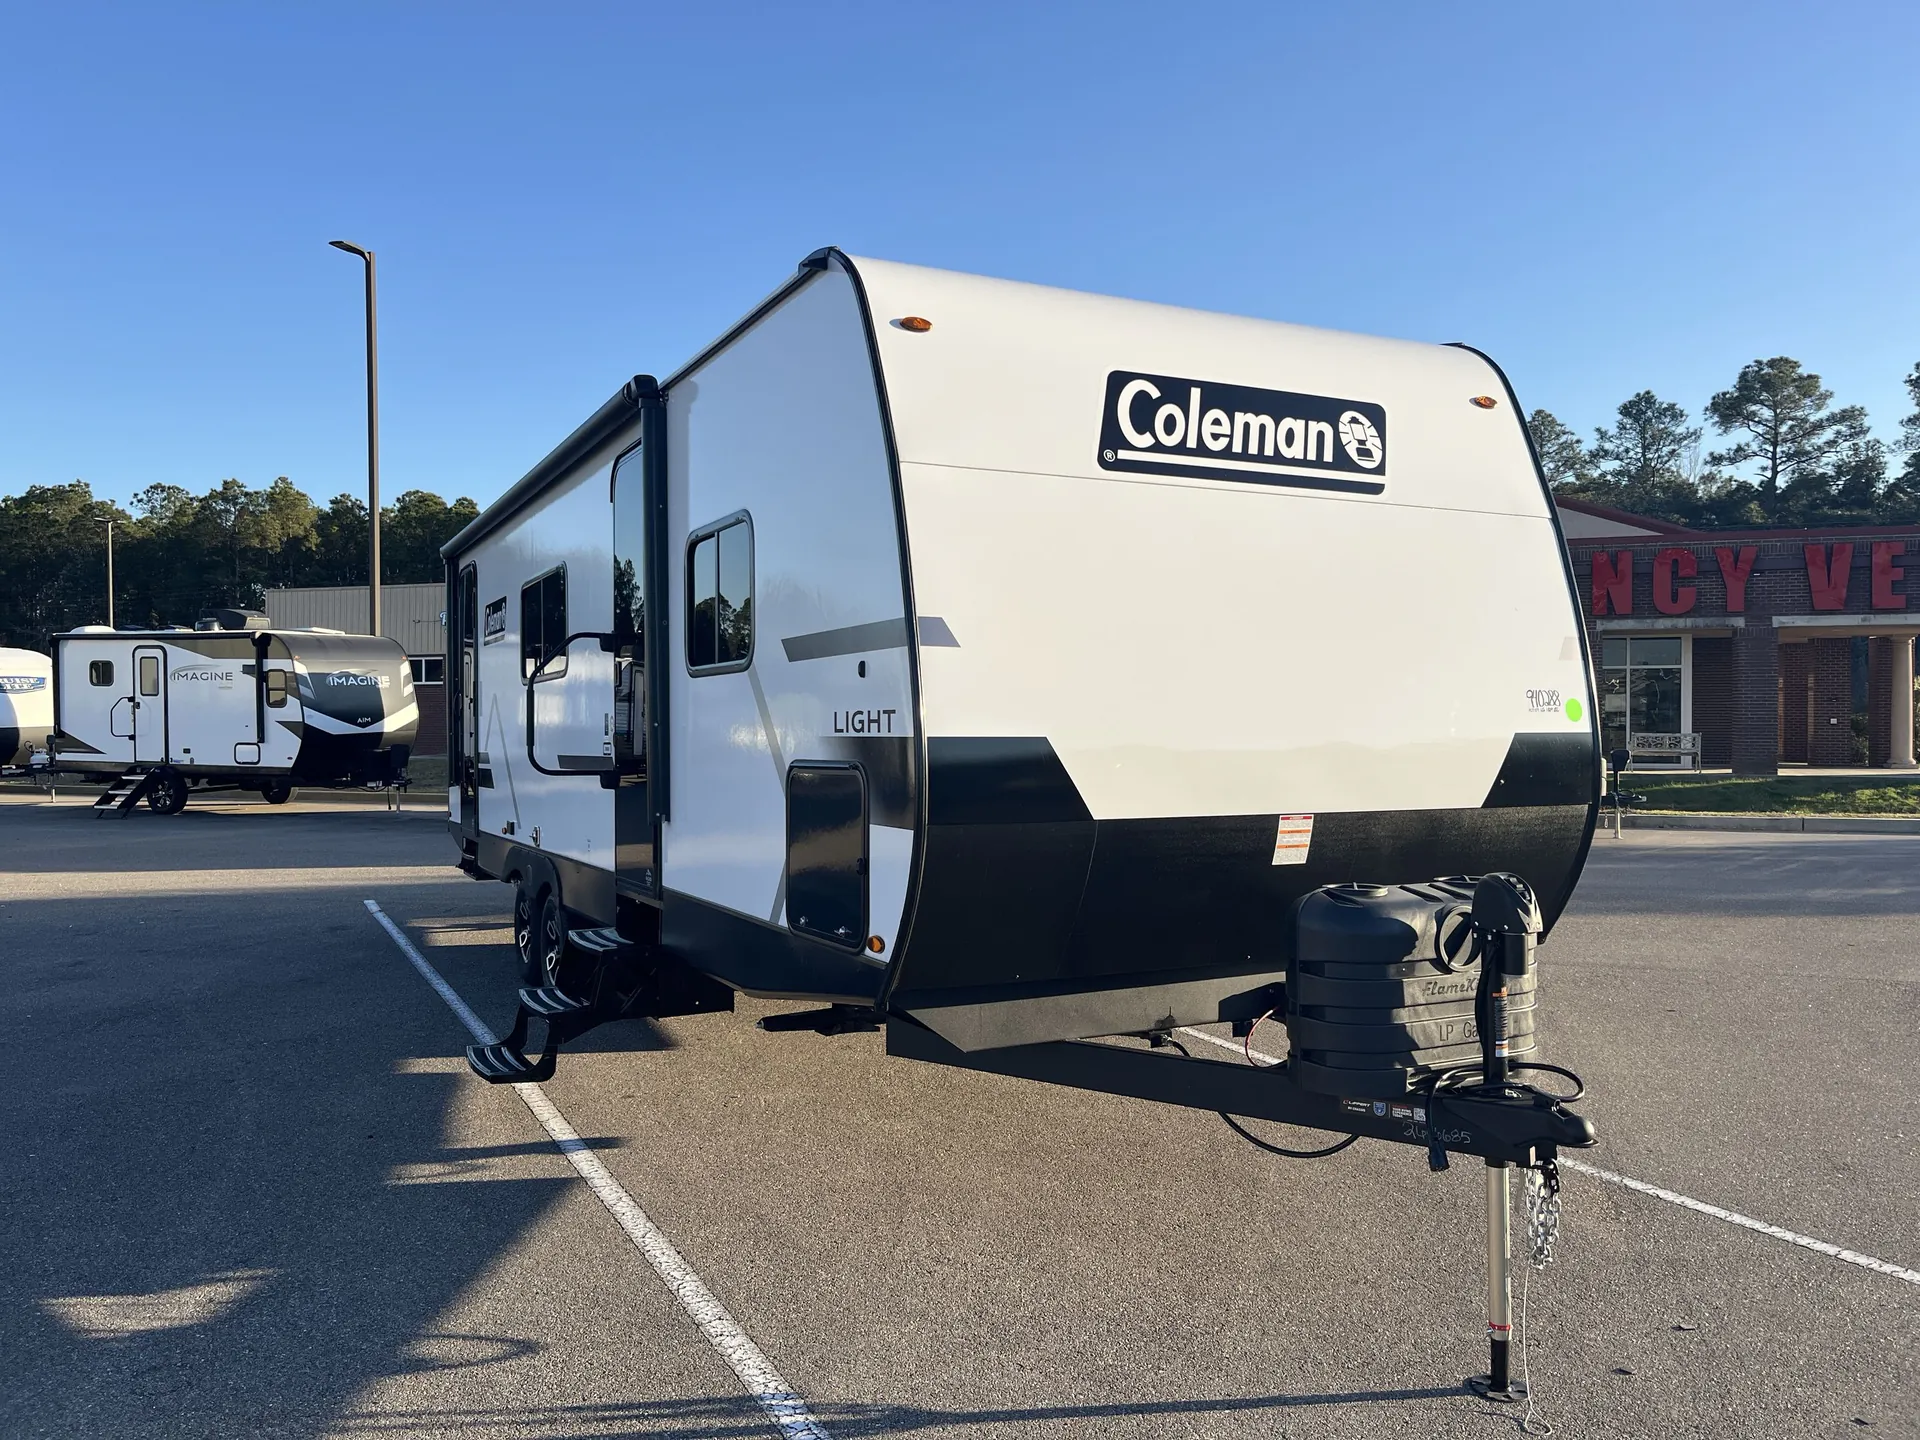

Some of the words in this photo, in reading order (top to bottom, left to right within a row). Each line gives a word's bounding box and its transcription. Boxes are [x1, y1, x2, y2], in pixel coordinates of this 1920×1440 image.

[1116, 379, 1334, 463] Coleman
[1592, 546, 1759, 616] NCY
[1804, 541, 1907, 611] VE
[173, 672, 233, 681] IMAGINE
[329, 675, 390, 686] IMAGINE
[834, 709, 896, 733] LIGHT
[1421, 977, 1479, 996] FlameK
[1439, 1024, 1454, 1041] LP
[1463, 1021, 1478, 1039] Ga
